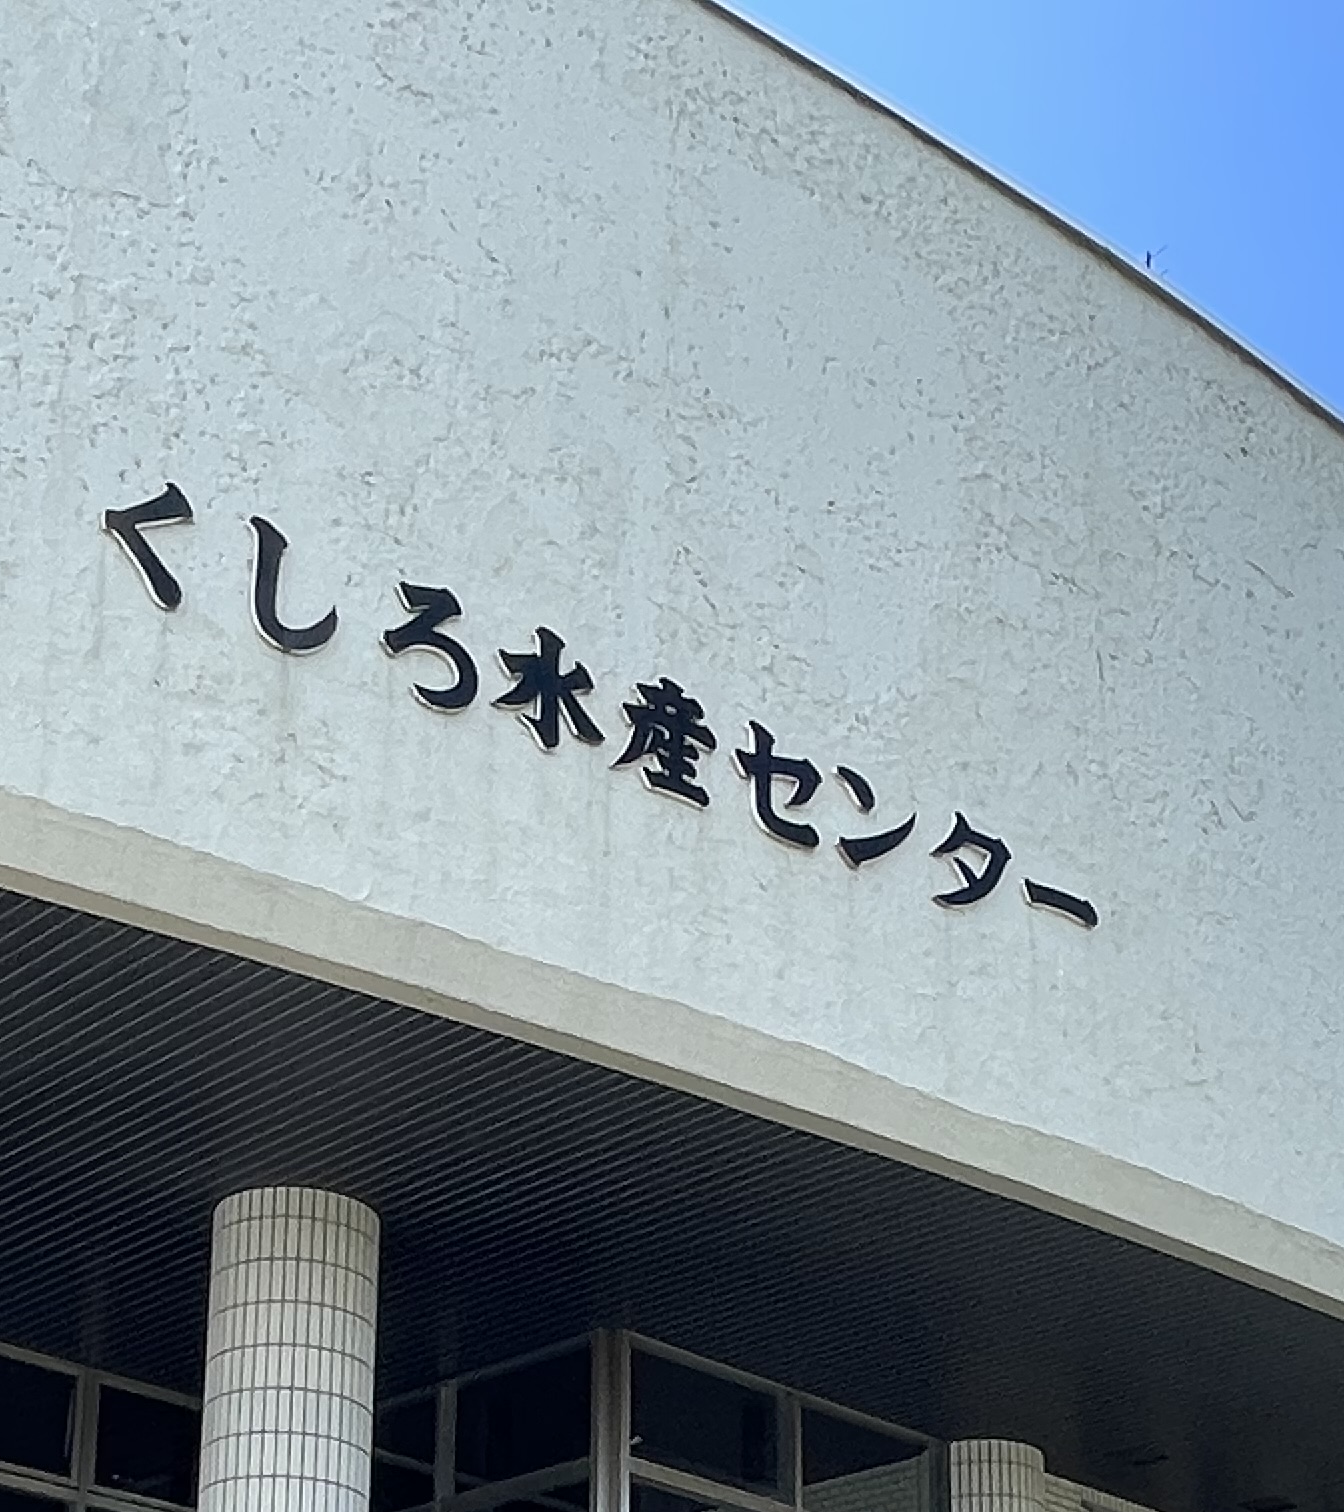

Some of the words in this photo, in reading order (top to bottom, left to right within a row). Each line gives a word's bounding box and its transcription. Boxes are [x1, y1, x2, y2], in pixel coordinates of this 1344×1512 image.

[101, 481, 1098, 928] くしろ水産センター
